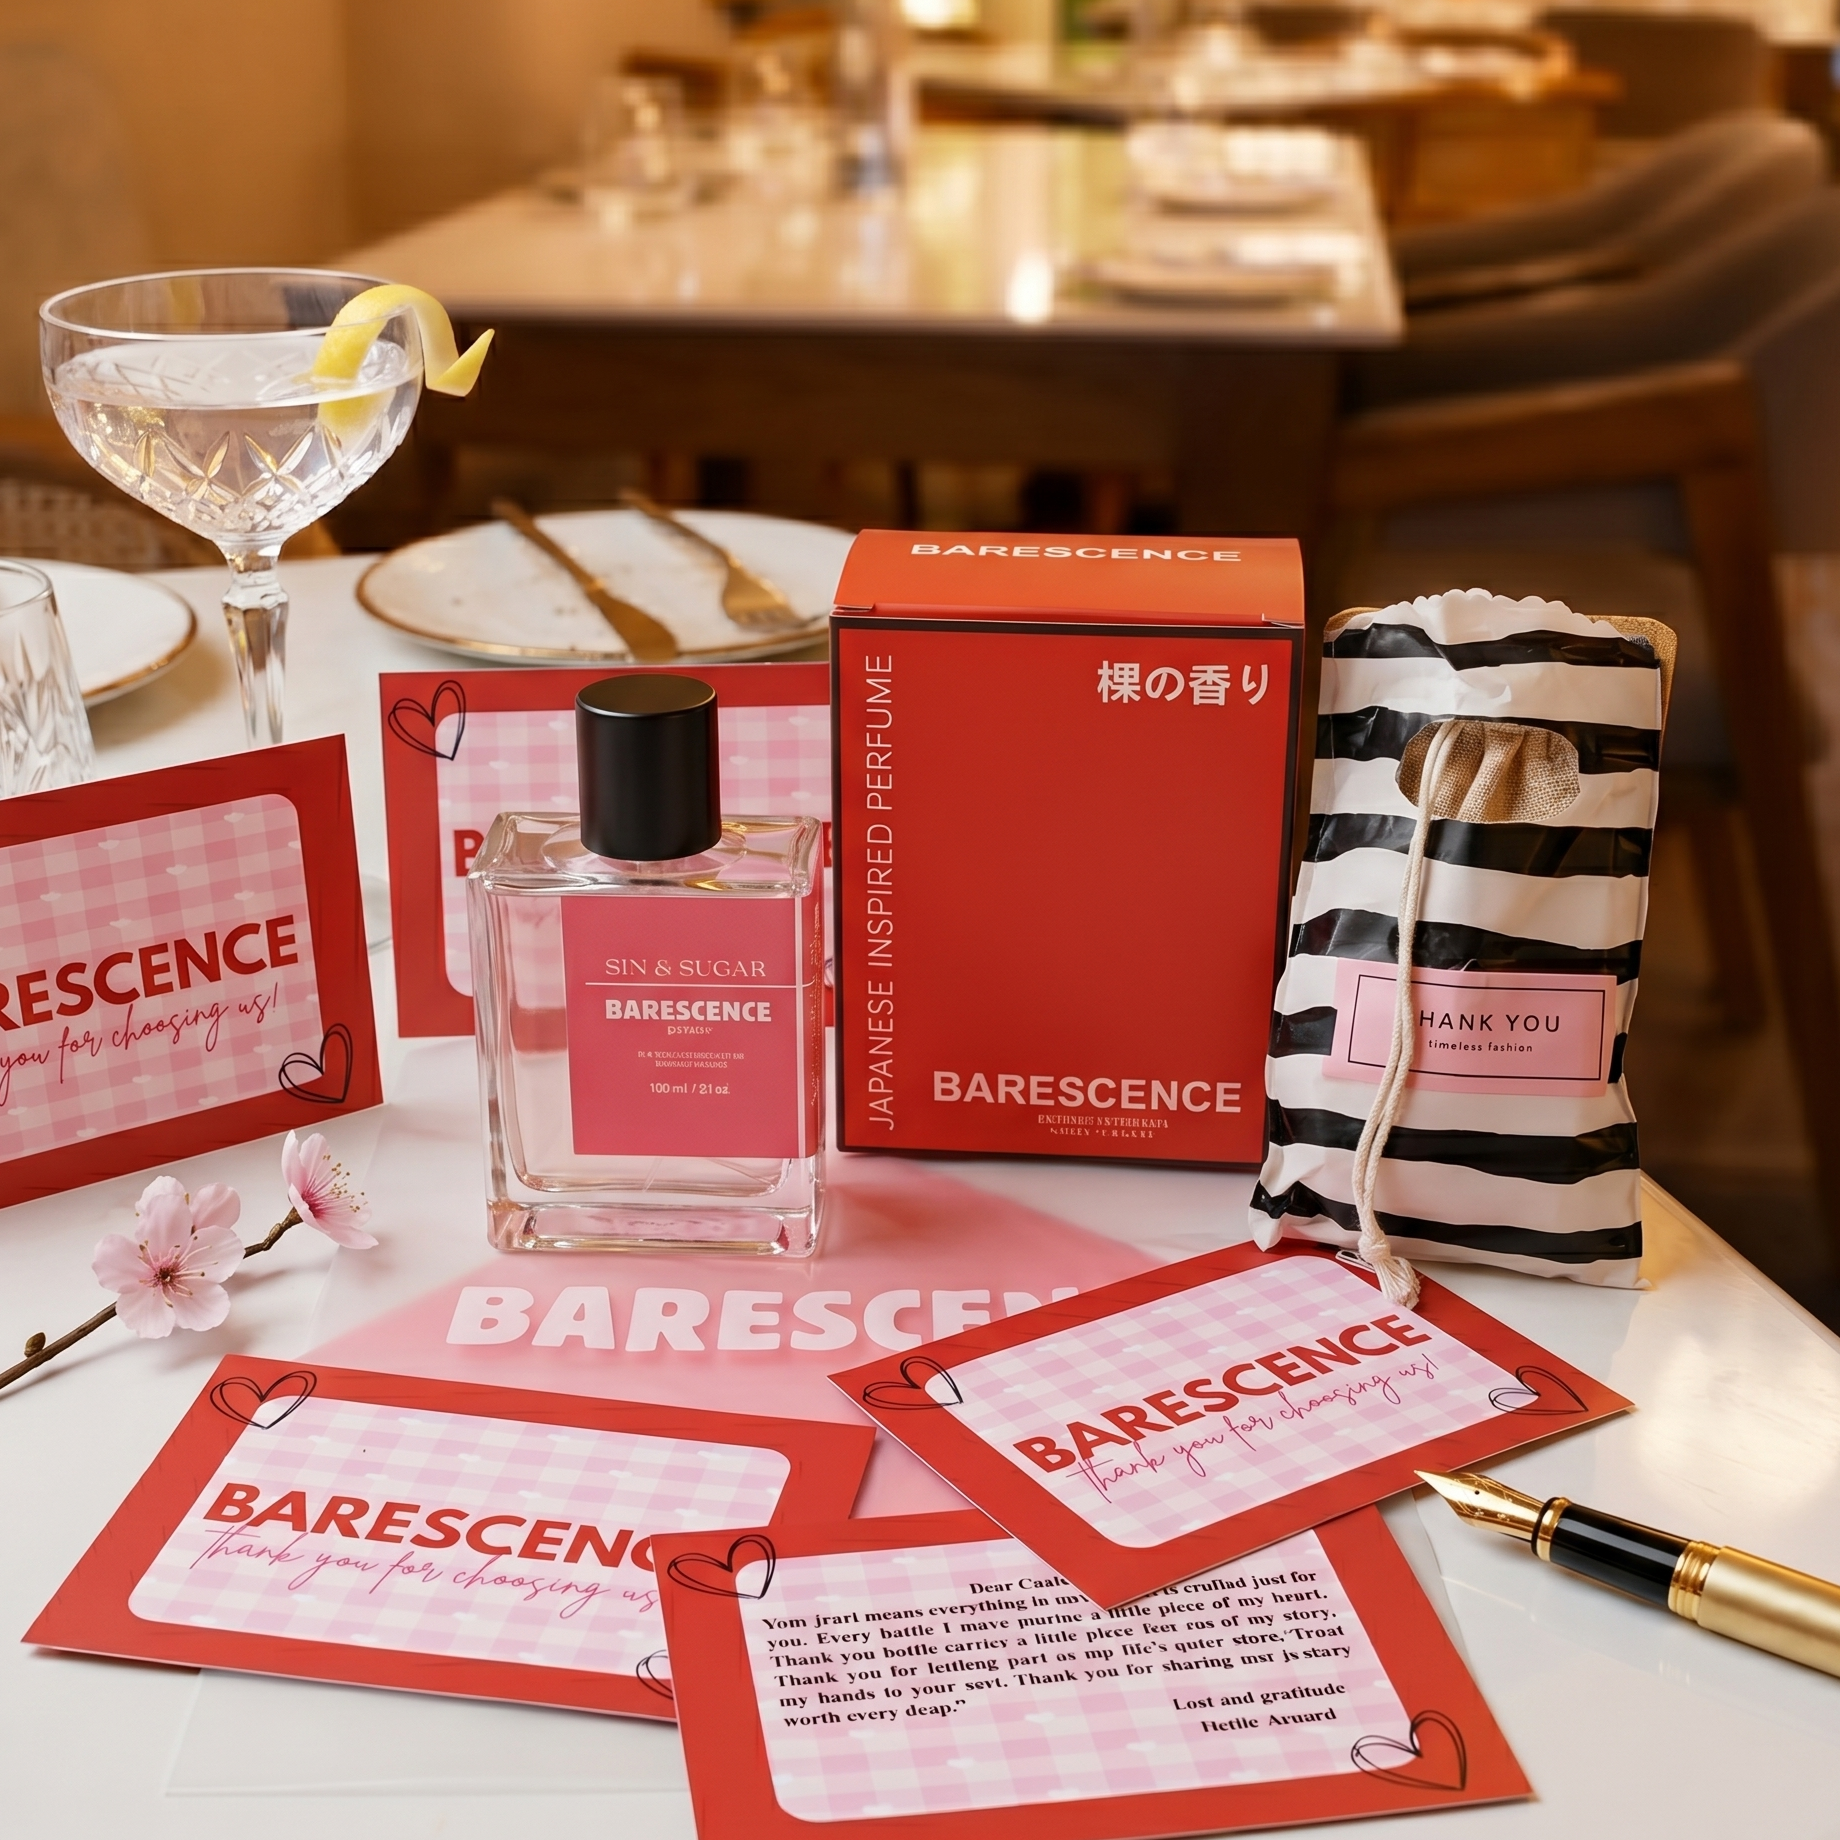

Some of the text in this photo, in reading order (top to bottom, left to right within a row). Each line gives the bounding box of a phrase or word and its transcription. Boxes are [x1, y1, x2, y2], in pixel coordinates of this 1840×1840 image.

[911, 544, 1242, 562] BARESCENCE
[865, 655, 895, 1131] JAPANESE INSPIRED PERFUME
[605, 959, 767, 977] SIN & SUGAR
[605, 999, 772, 1022] BARESCENCE
[1419, 1010, 1560, 1032] HANK YOU
[58, 1026, 103, 1084] for
[112, 1003, 229, 1052] choosing
[1428, 1040, 1533, 1053] timeless fashion
[650, 1082, 670, 1094] 100
[672, 1083, 688, 1094] ml
[933, 1070, 1242, 1113] BARESCENCE
[1012, 1314, 1433, 1473] BARESCENCE
[1065, 1441, 1166, 1504] thank
[1173, 1431, 1225, 1477] you
[1223, 1415, 1274, 1452] for
[1280, 1374, 1402, 1421] choosing
[189, 1525, 308, 1569] thank
[288, 1550, 379, 1591] you
[370, 1550, 443, 1594] for
[453, 1553, 611, 1619] choosing
[969, 1582, 1013, 1594] Dear
[865, 1608, 924, 1622] means
[929, 1599, 1028, 1615] everything
[1251, 1574, 1287, 1590] just
[1290, 1571, 1317, 1583] for
[767, 1638, 807, 1652] you.
[817, 1632, 870, 1644] Every
[880, 1625, 934, 1639] battle
[943, 1622, 951, 1634] I
[1091, 1612, 1101, 1620] a
[1212, 1597, 1230, 1609] of
[1237, 1596, 1264, 1608] my
[770, 1652, 834, 1667] Thank
[840, 1650, 876, 1665] you
[883, 1644, 938, 1658] bottle
[1017, 1638, 1028, 1647] a
[1034, 1631, 1077, 1644] little
[1221, 1615, 1239, 1628] of
[1247, 1614, 1274, 1627] my
[774, 1672, 839, 1687] Thank
[847, 1670, 882, 1684] you
[891, 1665, 917, 1677] for
[1007, 1653, 1048, 1669] part
[779, 1696, 808, 1708] my
[818, 1689, 875, 1704] hands
[884, 1687, 902, 1698] to
[911, 1683, 956, 1699] your
[1013, 1670, 1078, 1686] Thank
[1084, 1668, 1119, 1682] you
[1126, 1663, 1153, 1675] for
[1162, 1656, 1234, 1672] sharing
[1173, 1683, 1346, 1710] Lost and gratitude
[784, 1712, 841, 1727] worth
[847, 1709, 898, 1721] every
